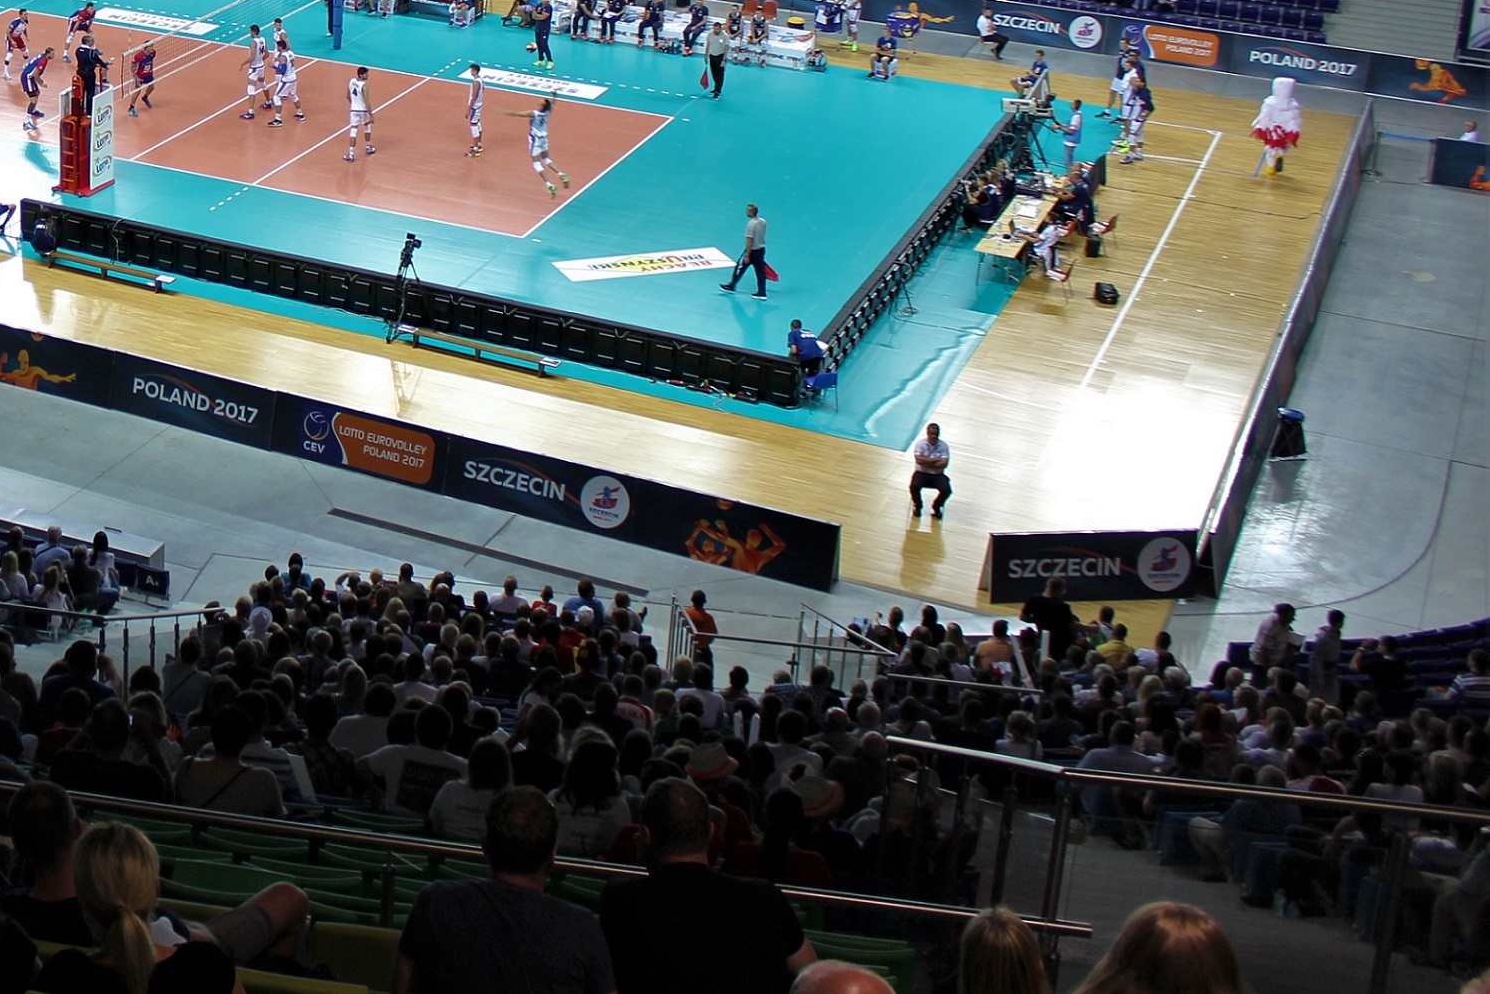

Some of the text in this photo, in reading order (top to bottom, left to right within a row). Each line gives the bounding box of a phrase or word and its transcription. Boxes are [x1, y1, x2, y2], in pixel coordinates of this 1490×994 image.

[992, 13, 1060, 35] SZCZECIN
[1147, 33, 1214, 47] LOTTO EUROVOLLEY
[1165, 44, 1212, 57] POLAND 2017
[1249, 50, 1357, 76] POLAND 2017
[352, 87, 358, 97] 4
[482, 74, 579, 94] SZCZECIN
[641, 260, 712, 273] BLACHY
[132, 377, 258, 424] POLAND 2017
[303, 440, 325, 454] CEV
[339, 425, 428, 456] LOTTO EUROVOLLEY
[363, 445, 425, 469] POLAND 2017
[463, 460, 566, 502] SZCZECIN
[588, 507, 620, 519] SZCZECIN
[1008, 557, 1121, 579] SZCZECIN
